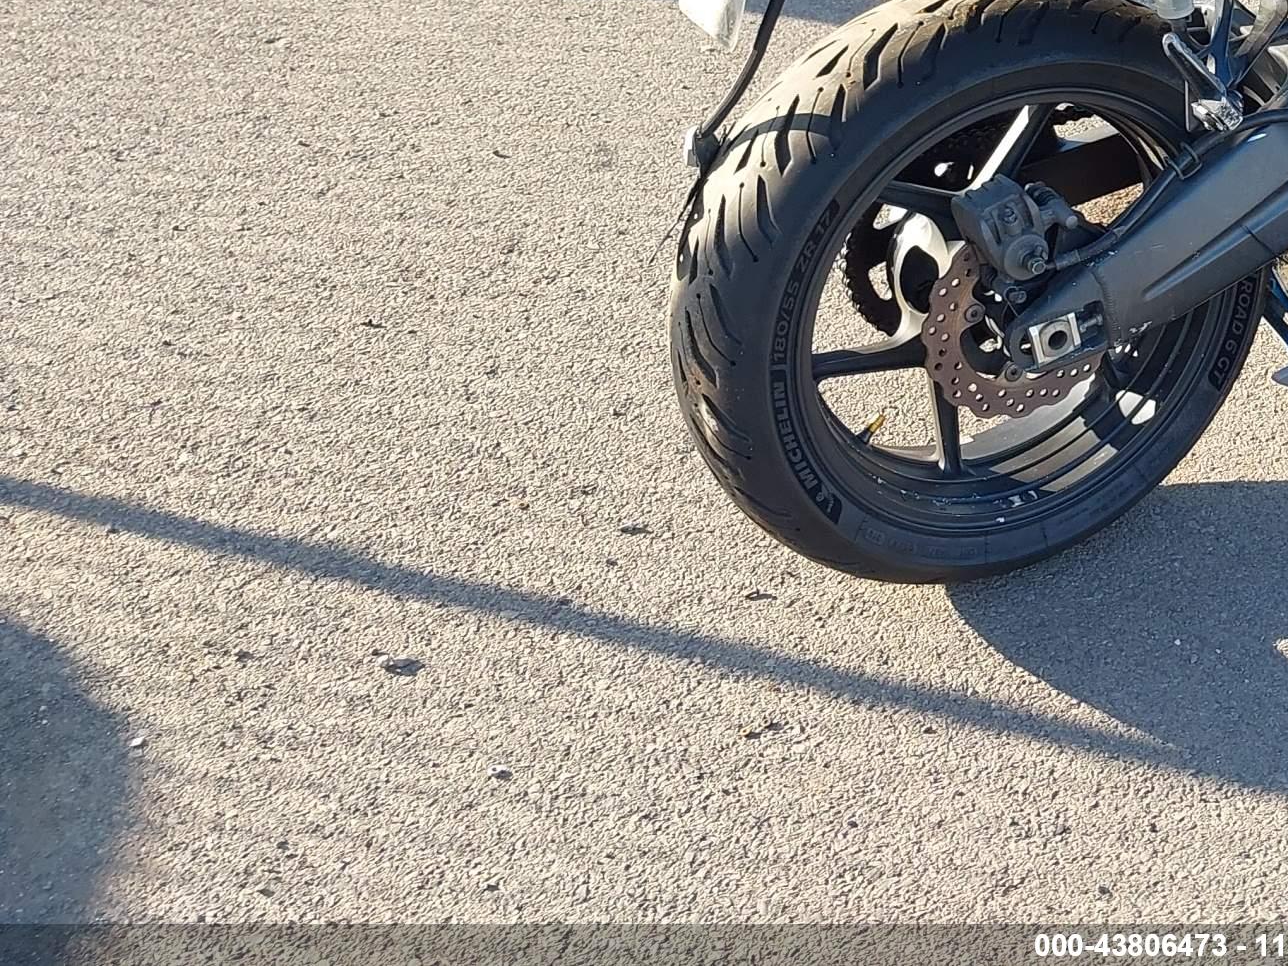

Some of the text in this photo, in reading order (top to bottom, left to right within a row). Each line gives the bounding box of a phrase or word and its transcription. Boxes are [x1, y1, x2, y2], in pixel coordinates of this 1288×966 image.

[774, 281, 800, 364] 180/55
[799, 241, 817, 273] ZR
[1232, 279, 1253, 334] ROAD
[1213, 357, 1230, 384] GT
[774, 381, 818, 489] MICHELIN
